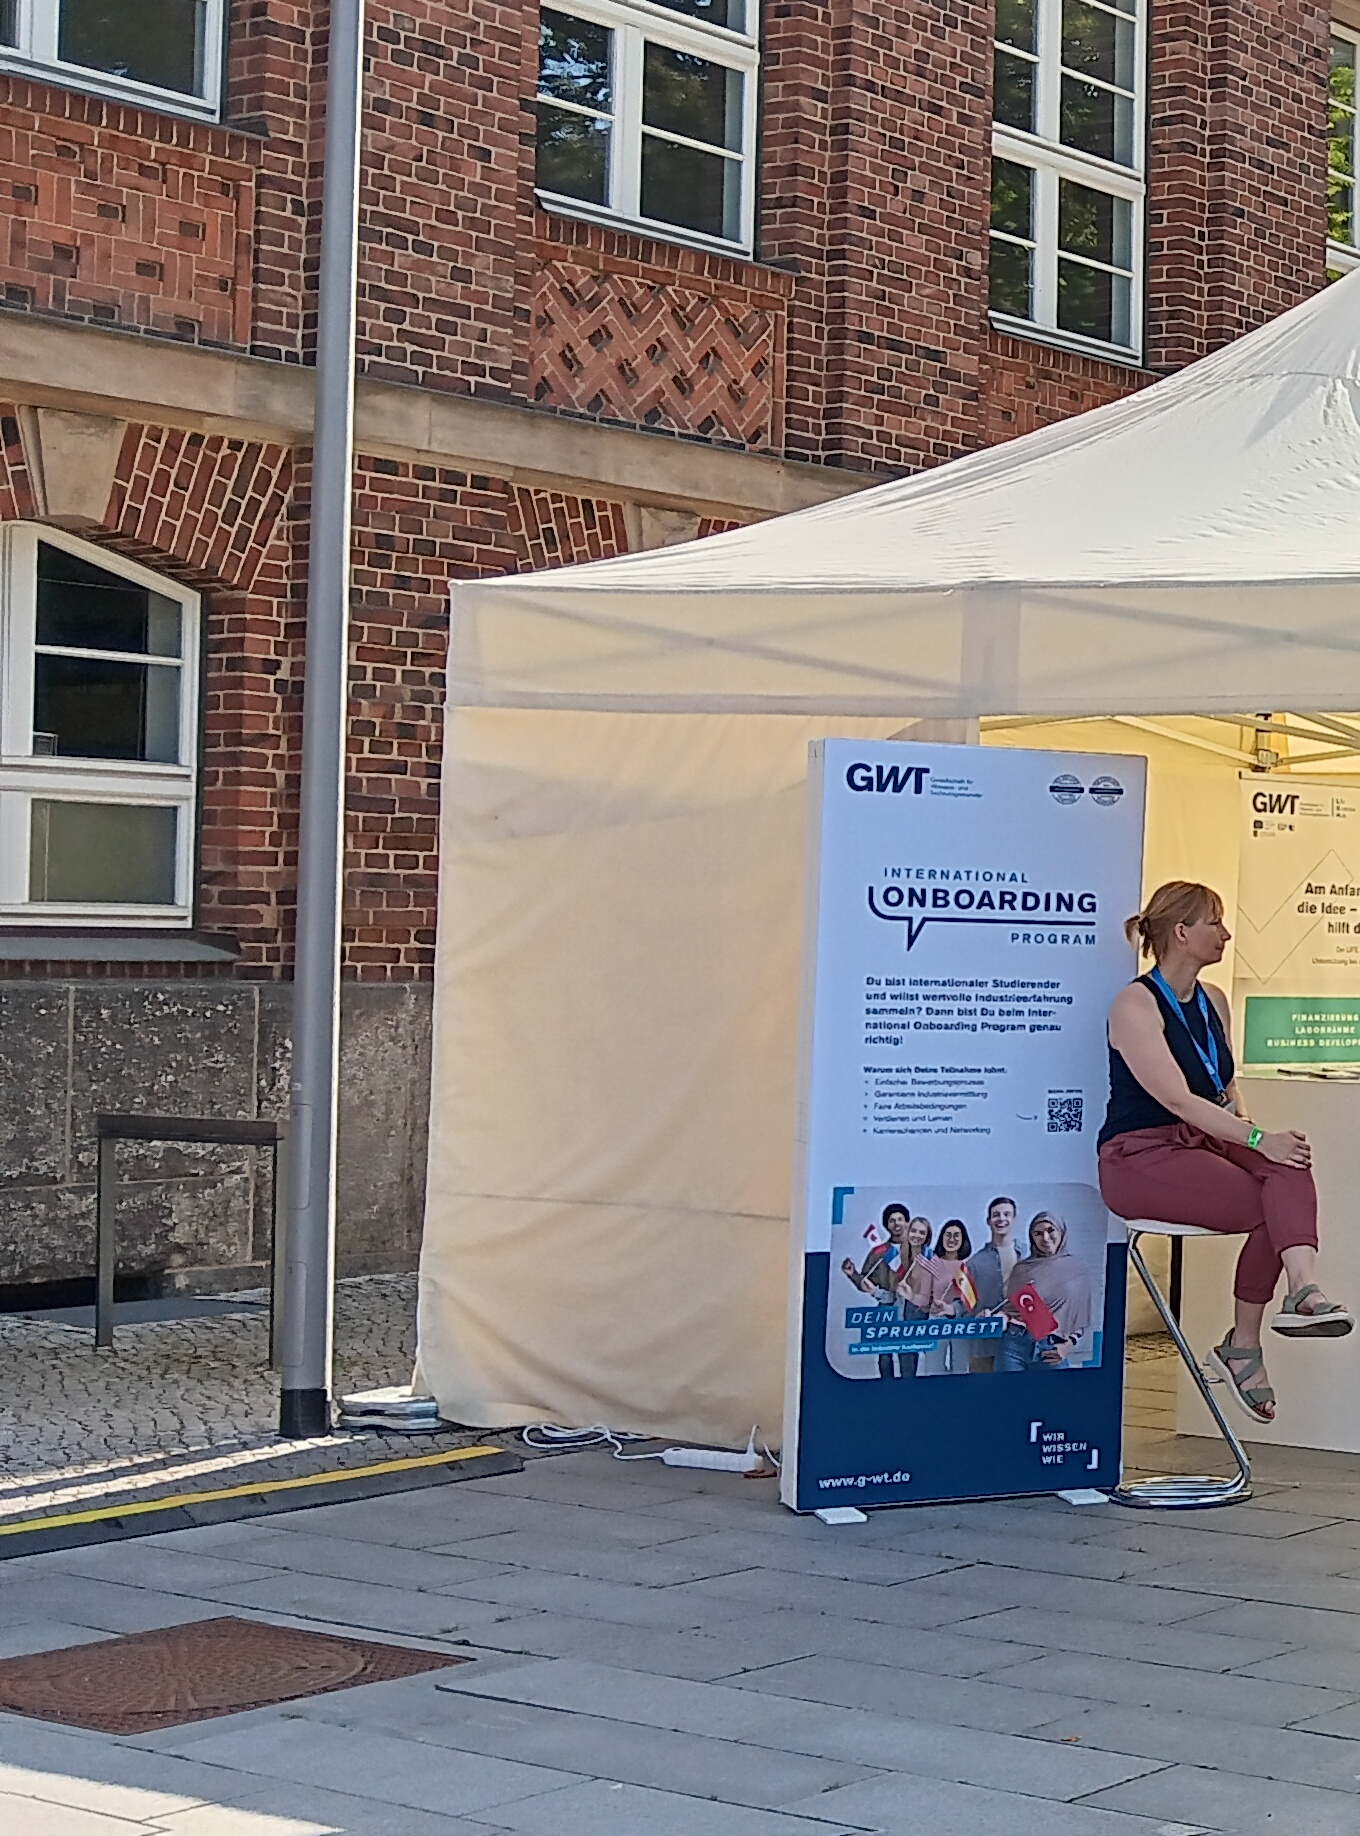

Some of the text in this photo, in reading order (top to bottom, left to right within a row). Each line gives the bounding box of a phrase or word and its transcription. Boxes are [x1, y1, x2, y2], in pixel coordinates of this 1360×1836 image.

[846, 763, 930, 794] GWT
[1252, 792, 1300, 815] GWT
[884, 867, 1028, 884] INTERNATIONAL
[1304, 882, 1326, 895] Am
[882, 886, 1097, 913] ONBOARDING
[1297, 901, 1317, 914] die
[1321, 902, 1346, 915] Idee
[1327, 921, 1350, 934] hilft
[1010, 932, 1096, 945] PROGRAM
[866, 976, 1061, 990] Du bist internationaler Studierender
[866, 991, 1074, 1005] und willst wertvolle Industrieerfahrung
[865, 1006, 1057, 1018] sammeln? Dann bist Du beim Inter-
[1291, 1013, 1360, 1022] FINANZIERUNG
[865, 1021, 1062, 1034] national Onboarding Program genau
[864, 1035, 904, 1046] richtig!
[1266, 1038, 1316, 1047] BUSINESS
[851, 1310, 895, 1324] DEIN
[866, 1321, 1000, 1339] SPRUNGBRETT
[1042, 1432, 1065, 1441] WIR
[1042, 1442, 1087, 1453] WISSEN
[1042, 1454, 1064, 1465] WIE
[818, 1470, 911, 1489] www.g-wt.de
